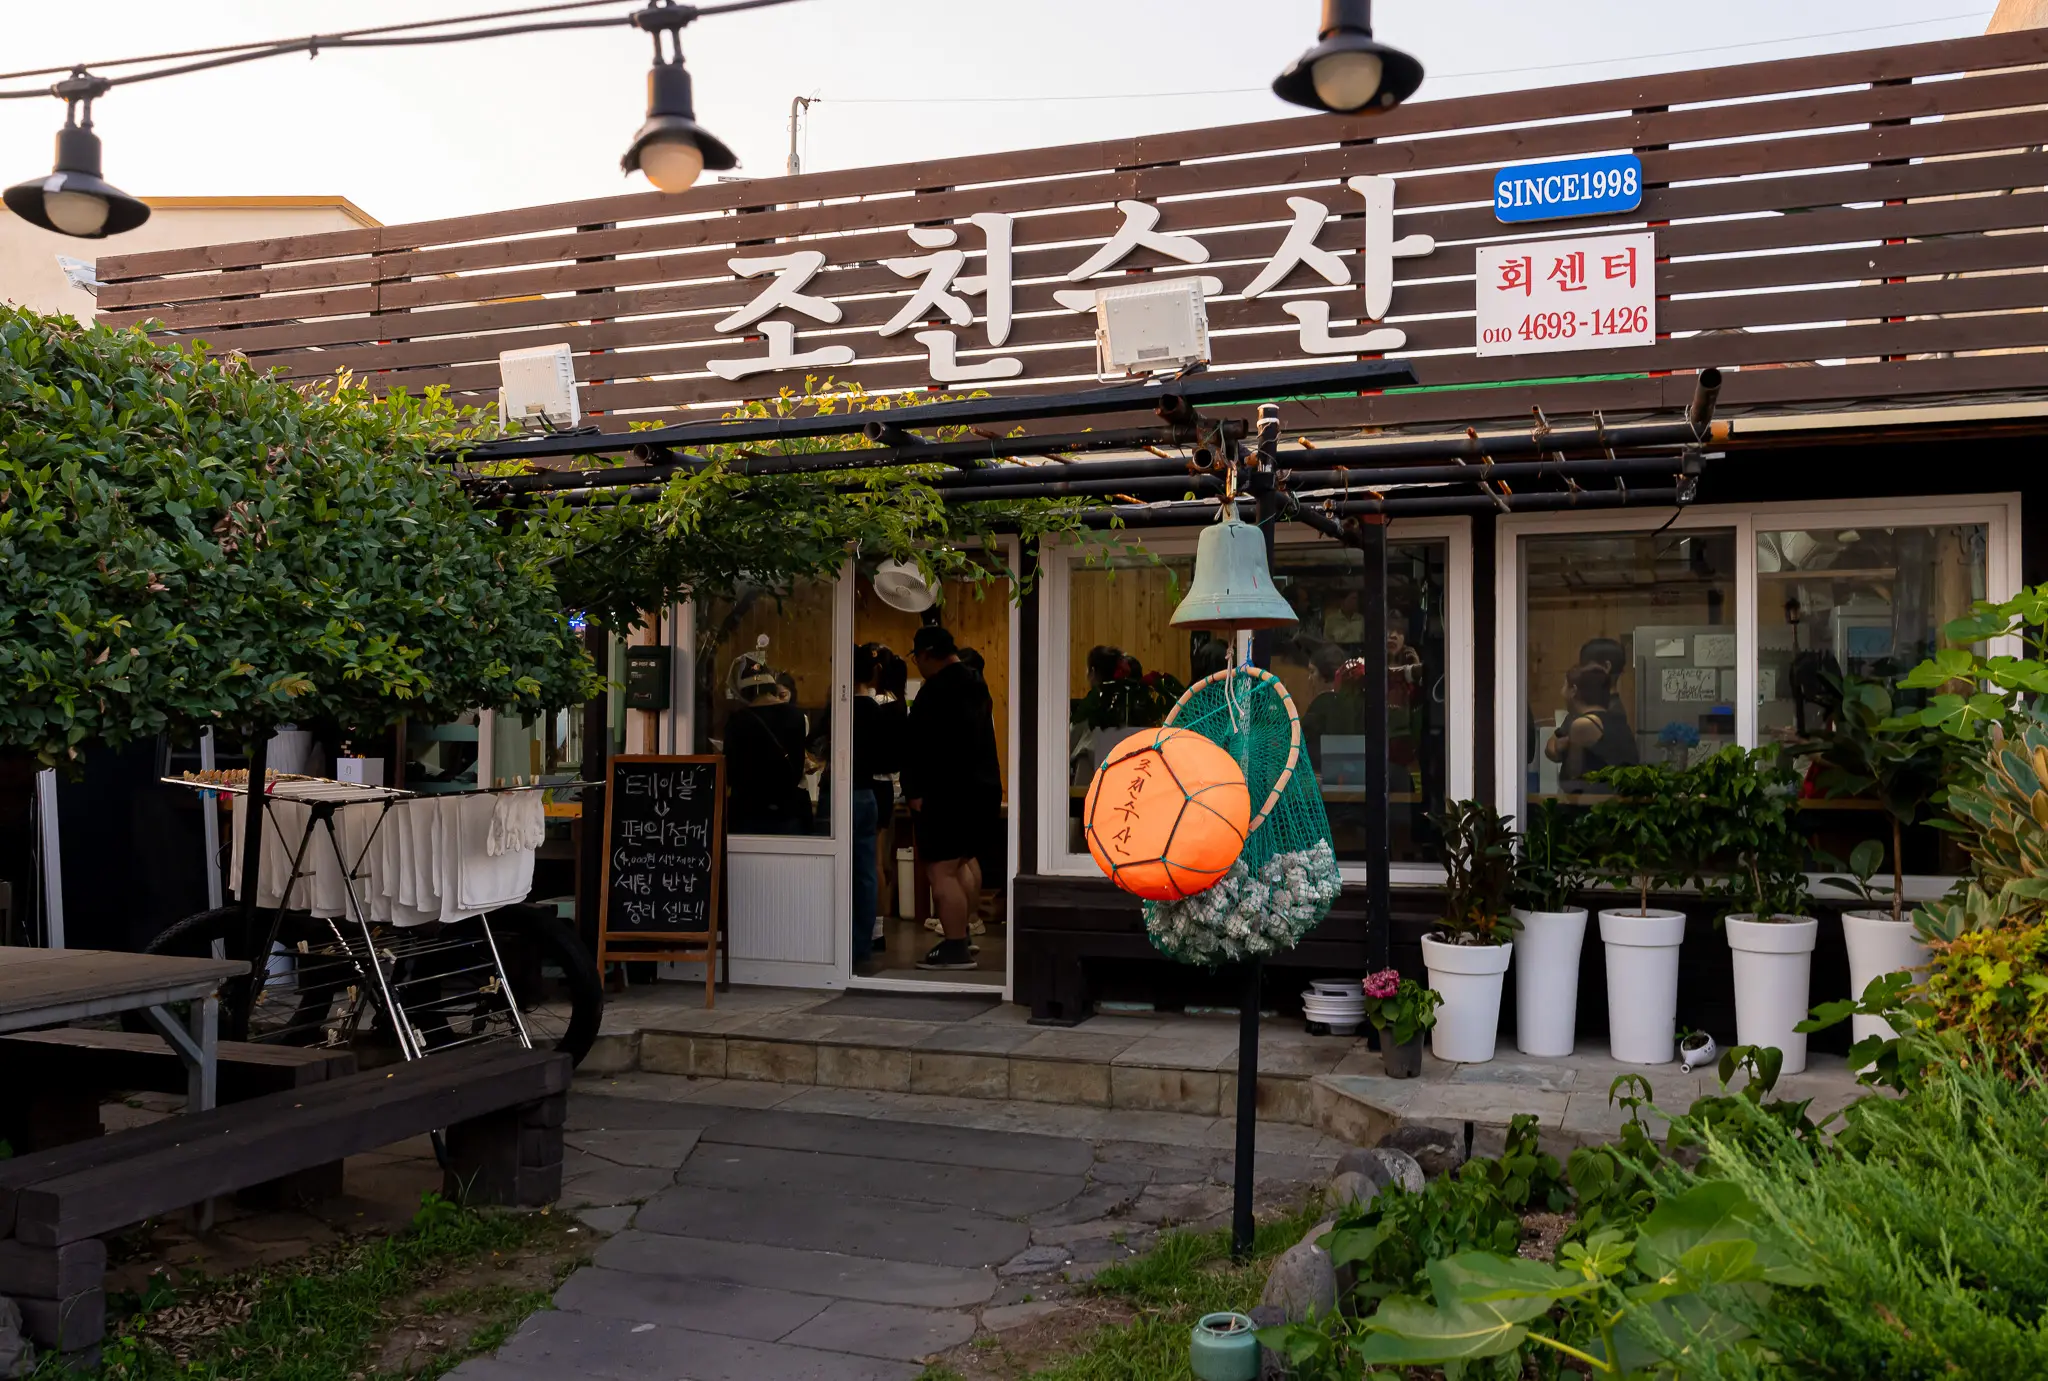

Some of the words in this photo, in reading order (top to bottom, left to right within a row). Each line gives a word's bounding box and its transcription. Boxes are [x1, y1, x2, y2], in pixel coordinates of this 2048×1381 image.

[1498, 167, 1638, 208] SINCE1998
[1482, 327, 1512, 344] 010
[1518, 306, 1648, 341] 4693-1426
[614, 873, 653, 895] 세팅
[623, 901, 655, 924] 정리
